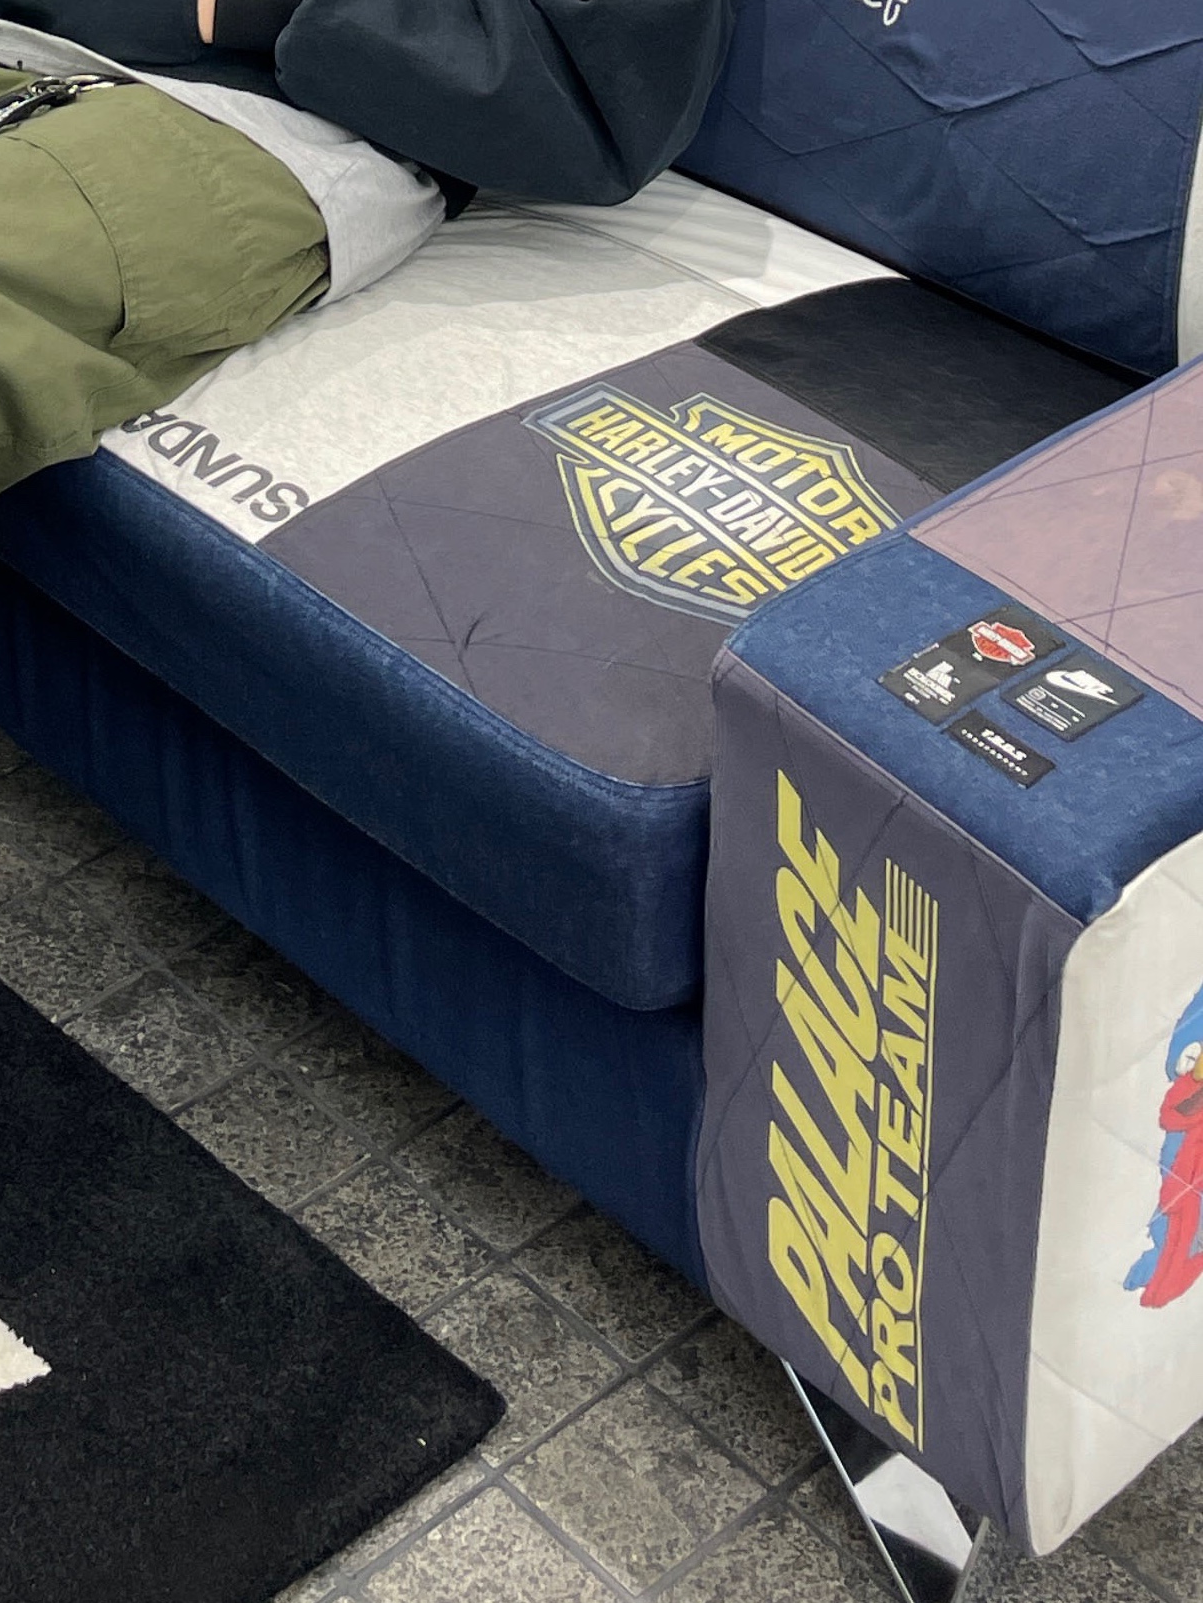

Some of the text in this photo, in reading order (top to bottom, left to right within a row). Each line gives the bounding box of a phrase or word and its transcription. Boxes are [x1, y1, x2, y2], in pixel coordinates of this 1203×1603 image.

[120, 409, 310, 523] SUNDA
[566, 405, 837, 582] HARLEY-DAVID
[597, 477, 770, 605] CYCLES
[700, 423, 883, 546] MOTOR
[767, 768, 881, 1409] PALACE
[871, 925, 928, 1445] PRO TEAM
